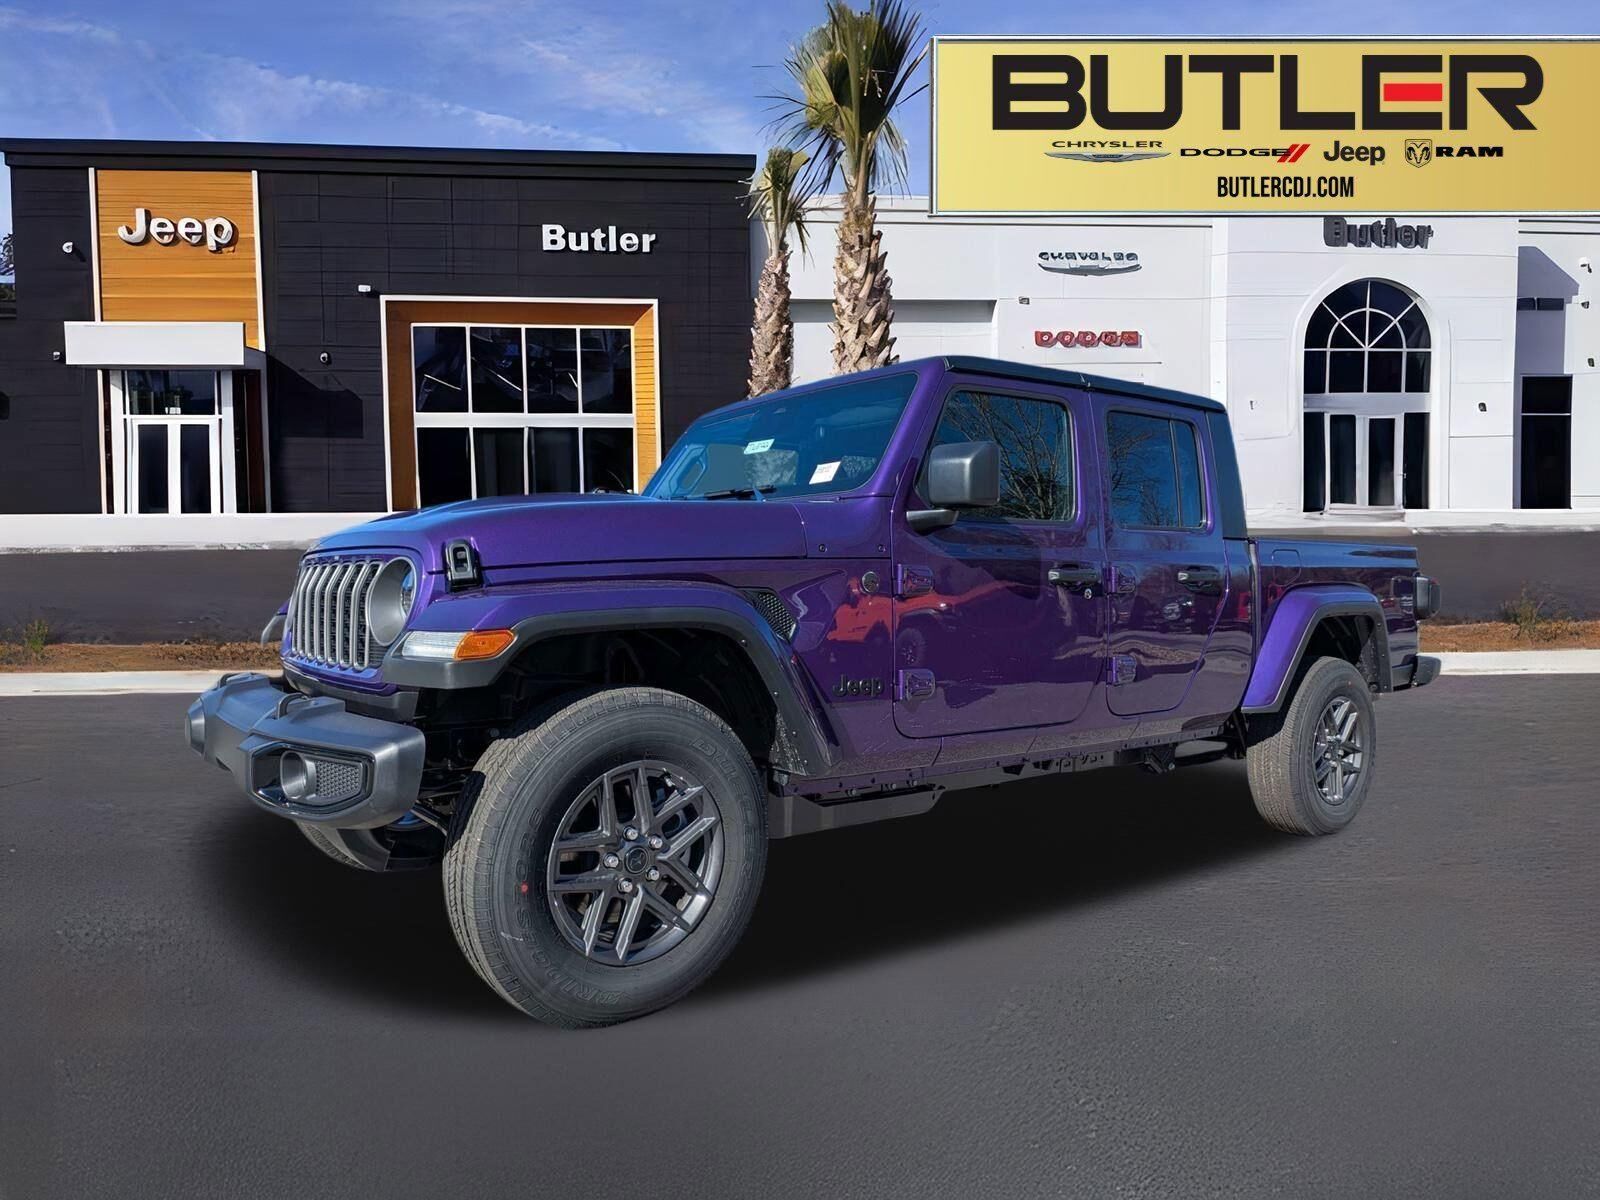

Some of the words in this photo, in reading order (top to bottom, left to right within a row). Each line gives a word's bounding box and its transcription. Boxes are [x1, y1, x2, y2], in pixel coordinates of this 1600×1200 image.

[992, 54, 1544, 131] BUTLER
[1051, 140, 1163, 148] CHRYSLER
[1180, 148, 1291, 157] DODGE
[1323, 140, 1386, 166] Jeep
[1435, 146, 1504, 158] RAM
[1217, 176, 1355, 198] BUTLERCDJ.COM
[117, 207, 235, 252] Jeep
[542, 223, 656, 253] Butler
[832, 674, 885, 698] Jeep
